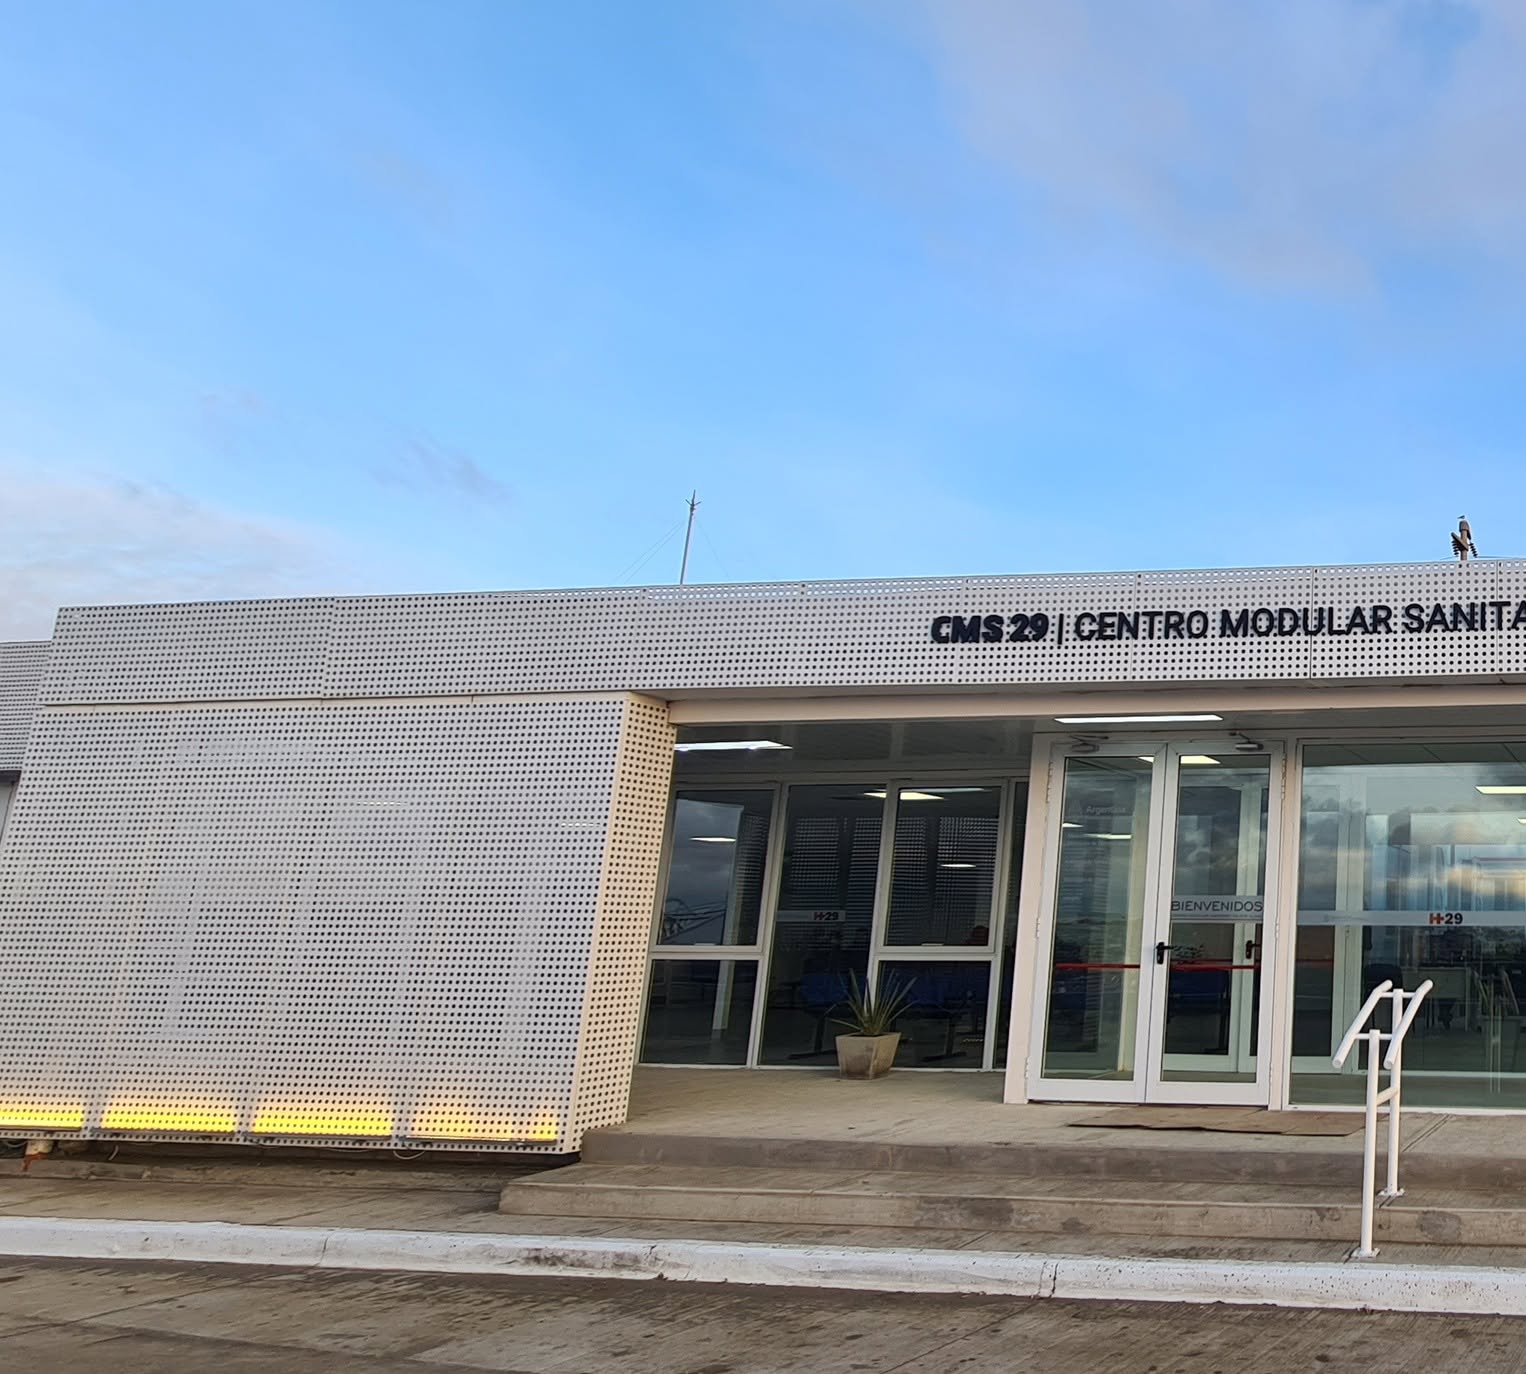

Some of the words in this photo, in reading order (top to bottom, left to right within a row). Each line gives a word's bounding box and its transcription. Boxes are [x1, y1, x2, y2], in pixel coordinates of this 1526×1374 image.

[931, 614, 1006, 643] CMS
[1009, 612, 1049, 642] 29
[1074, 611, 1210, 641] CENTRO
[1220, 605, 1393, 638] MODULAR
[1171, 900, 1264, 912] BIENVENIDOS
